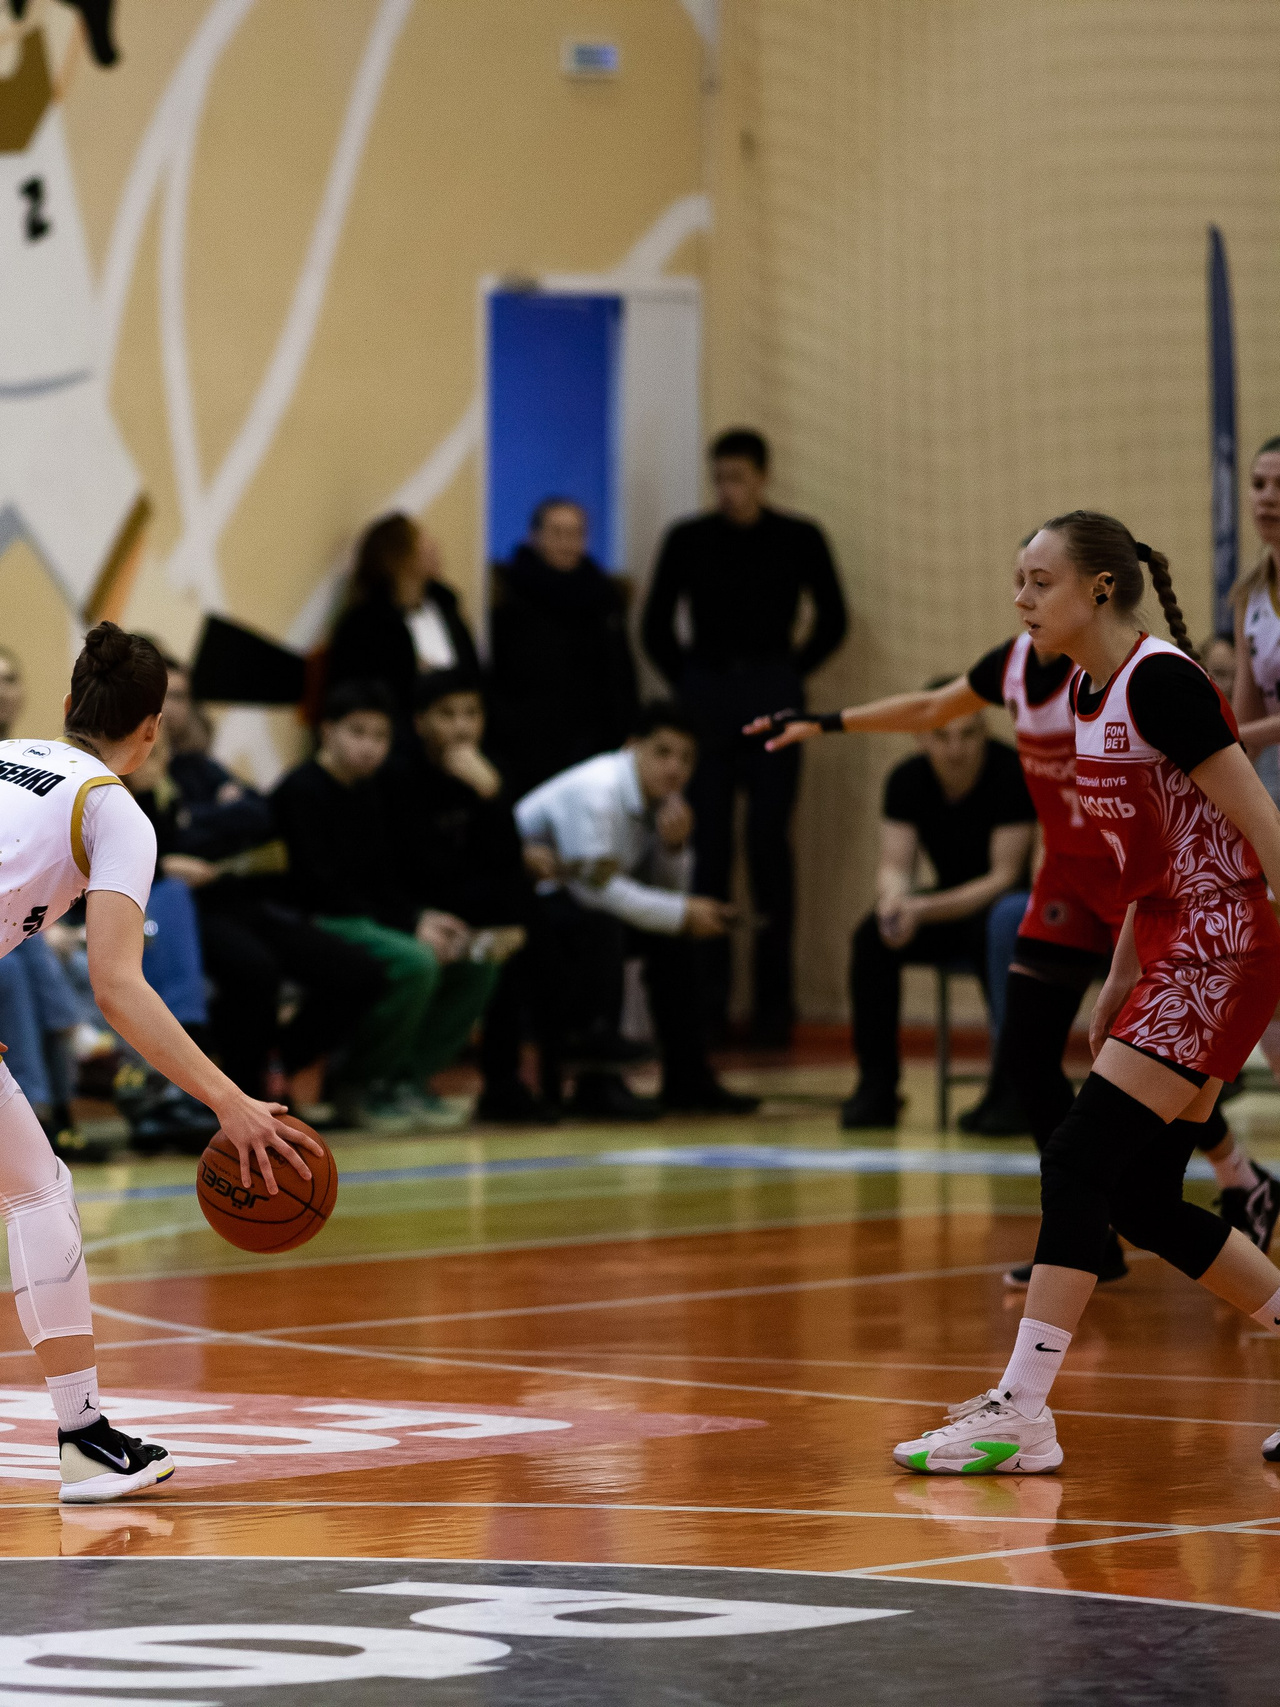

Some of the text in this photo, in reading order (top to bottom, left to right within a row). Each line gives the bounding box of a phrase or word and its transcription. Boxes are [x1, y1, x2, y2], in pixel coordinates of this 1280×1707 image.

[1105, 726, 1125, 738] FON
[1105, 738, 1127, 750] BET
[1101, 776, 1128, 788] КЛУБ
[1079, 795, 1137, 819] НОСТЬ
[202, 1160, 270, 1210] JÖGEL
